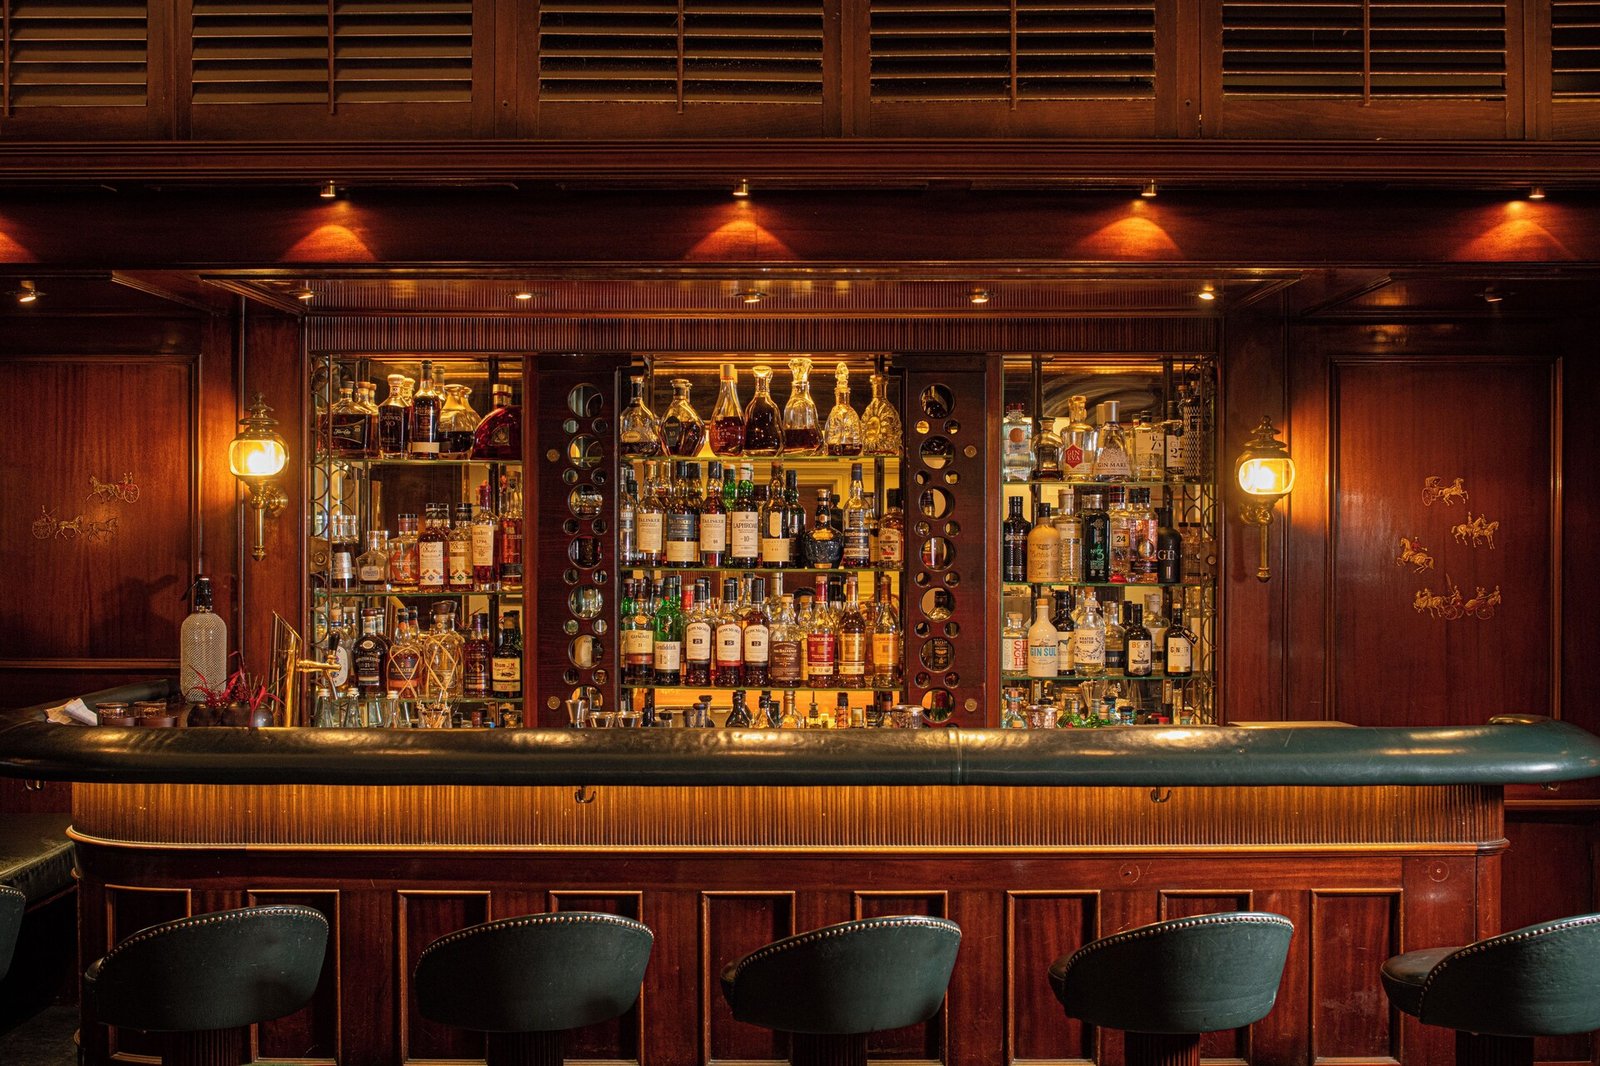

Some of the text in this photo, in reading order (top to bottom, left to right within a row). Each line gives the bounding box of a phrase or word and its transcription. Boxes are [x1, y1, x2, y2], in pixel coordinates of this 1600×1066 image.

[1170, 448, 1184, 459] 27
[1117, 535, 1126, 543] 24
[1030, 648, 1056, 657] GIN SUL
